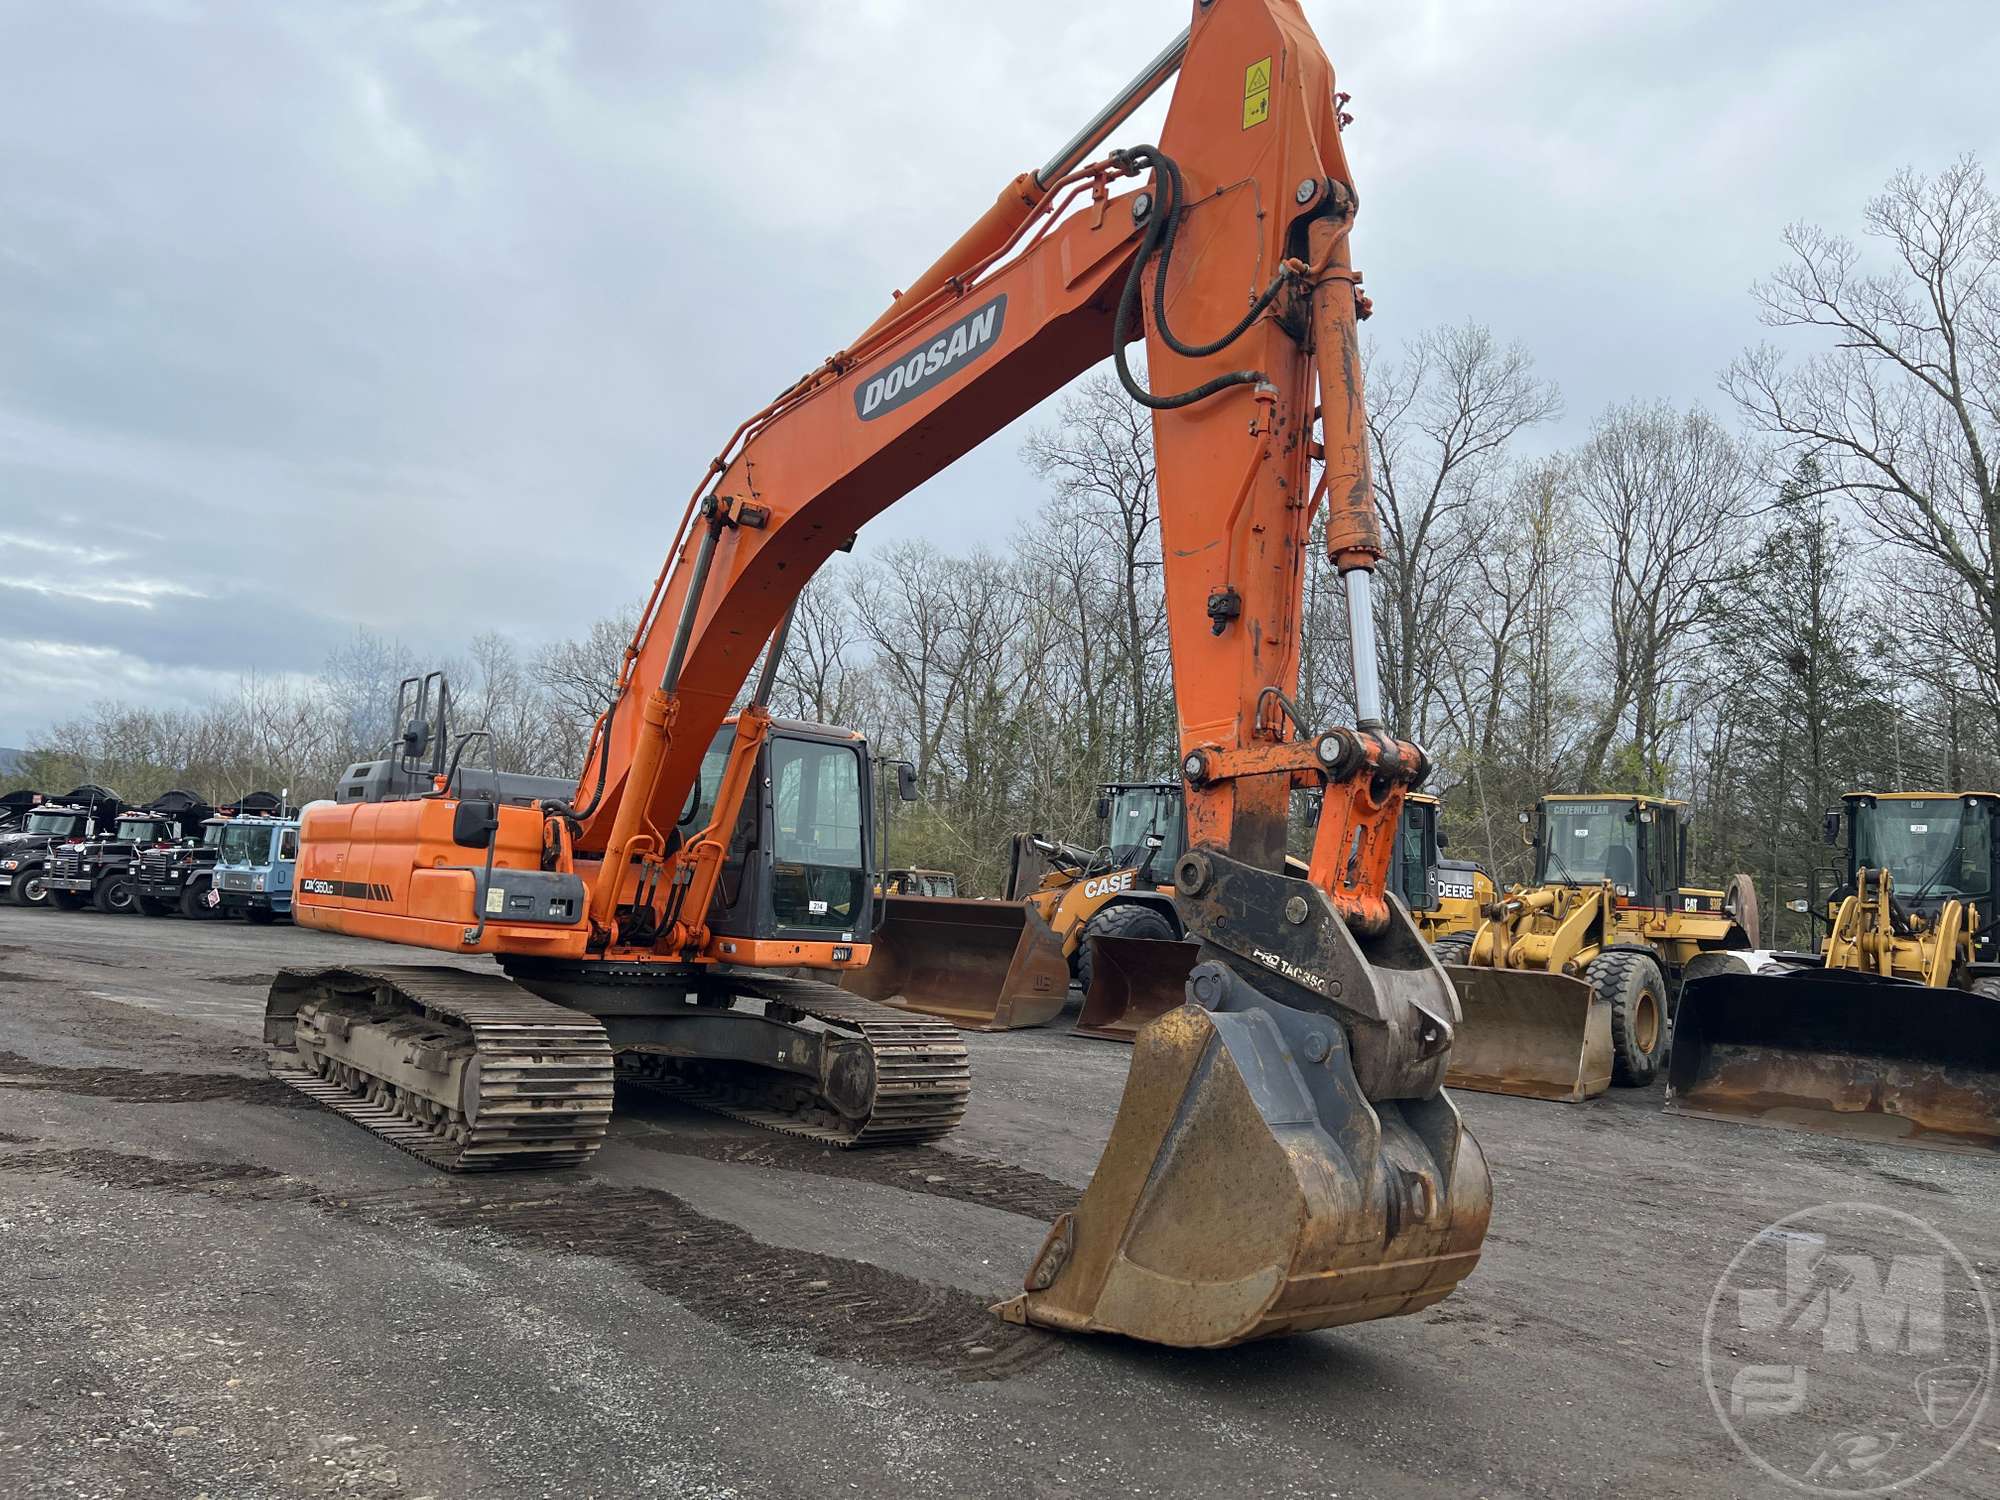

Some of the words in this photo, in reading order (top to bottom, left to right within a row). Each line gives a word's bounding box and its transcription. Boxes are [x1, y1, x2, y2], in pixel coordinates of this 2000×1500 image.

[862, 305, 996, 416] DOOSAN
[1553, 805, 1609, 815] CATERPILLAR
[1084, 872, 1132, 898] CASE
[1438, 880, 1474, 899] DEERE
[1685, 898, 1698, 913] CAT
